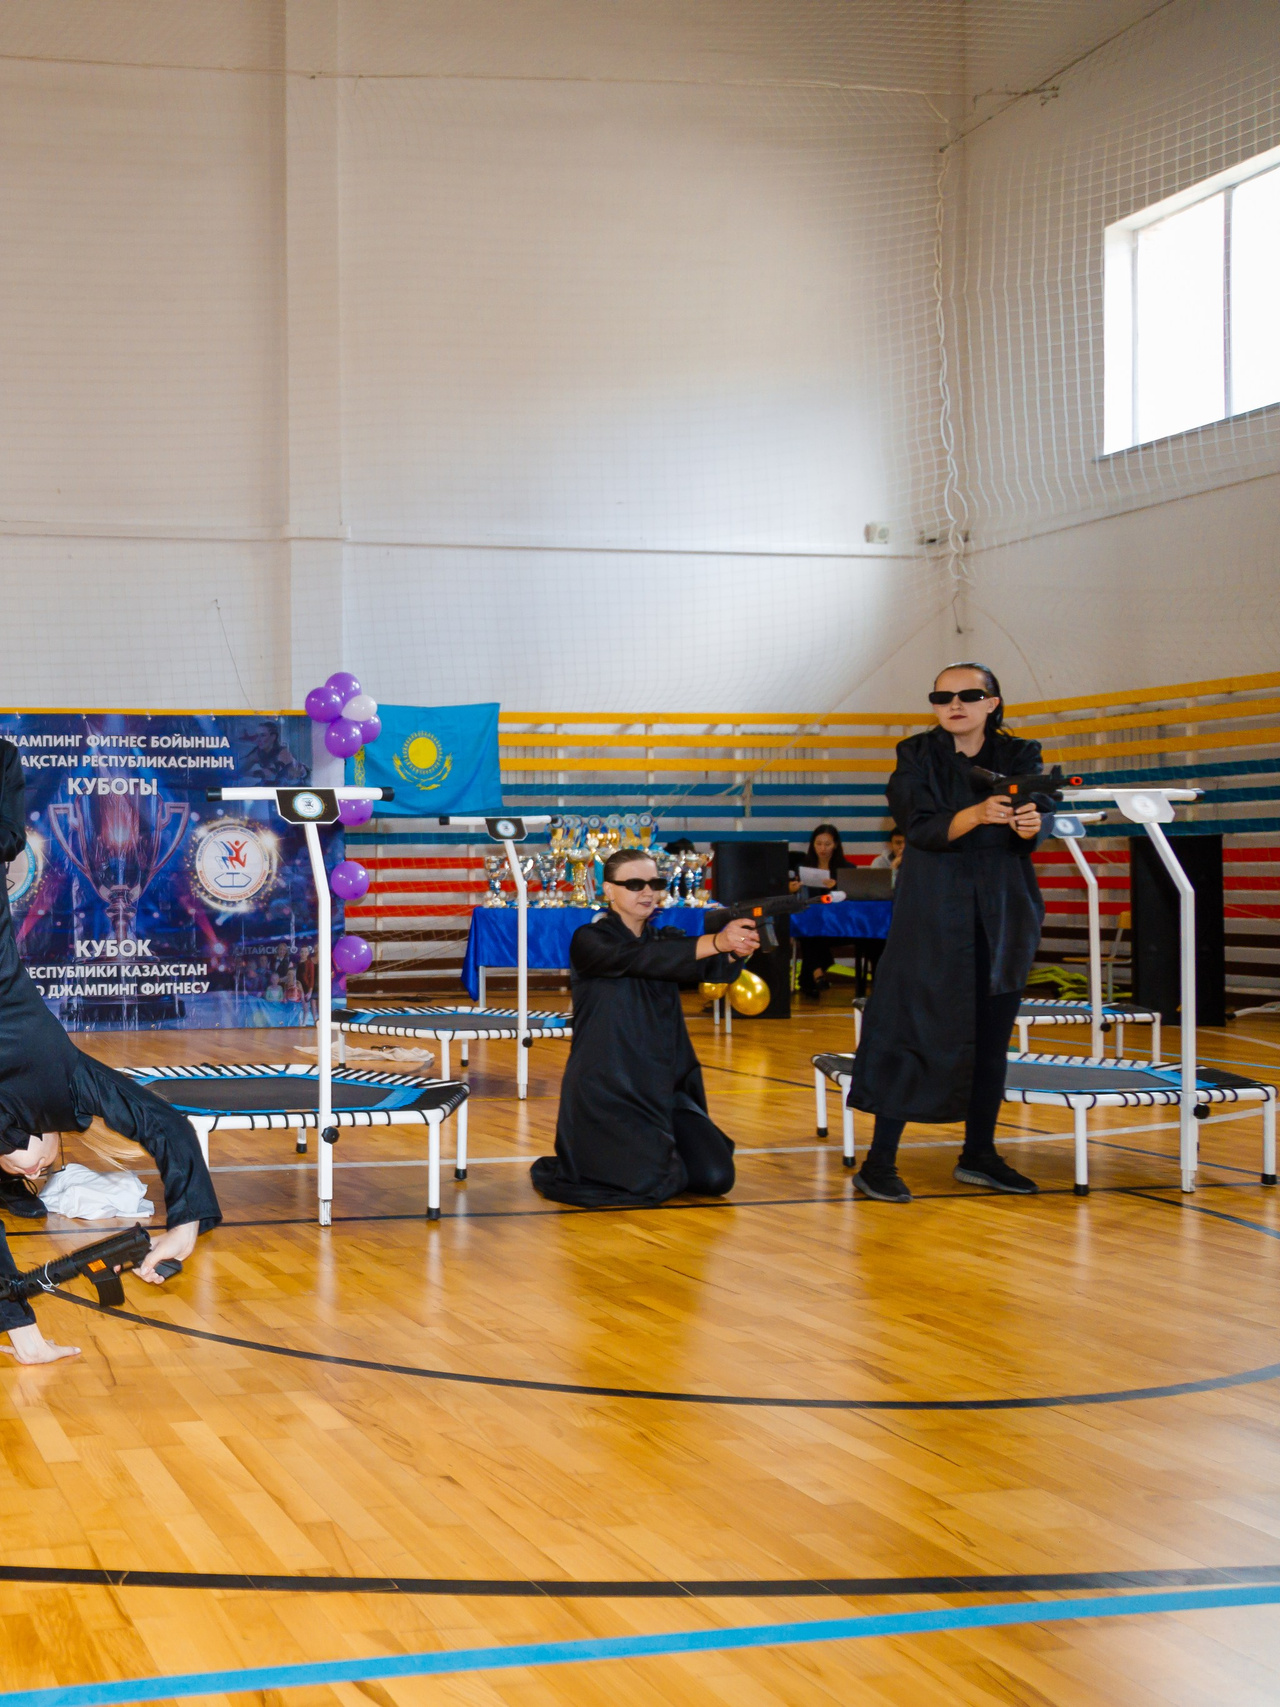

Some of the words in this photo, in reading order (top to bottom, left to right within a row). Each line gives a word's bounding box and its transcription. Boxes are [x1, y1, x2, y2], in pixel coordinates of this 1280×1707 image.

[86, 735, 147, 748] ФИТНЕС
[150, 733, 231, 749] БОЙЫНША
[21, 754, 81, 770] АҚСТАН
[82, 755, 235, 771] РЕСПУБЛИКАСЫНЫҢ
[67, 776, 158, 796] КУБОГЫ
[75, 939, 153, 958] КУБОК
[25, 965, 118, 979] ЕСПУБЛИКИ
[121, 963, 208, 978] КАЗАХСТАН
[48, 984, 138, 999] ДЖАМПИНГ
[140, 981, 210, 995] ФИТНЕСУ
